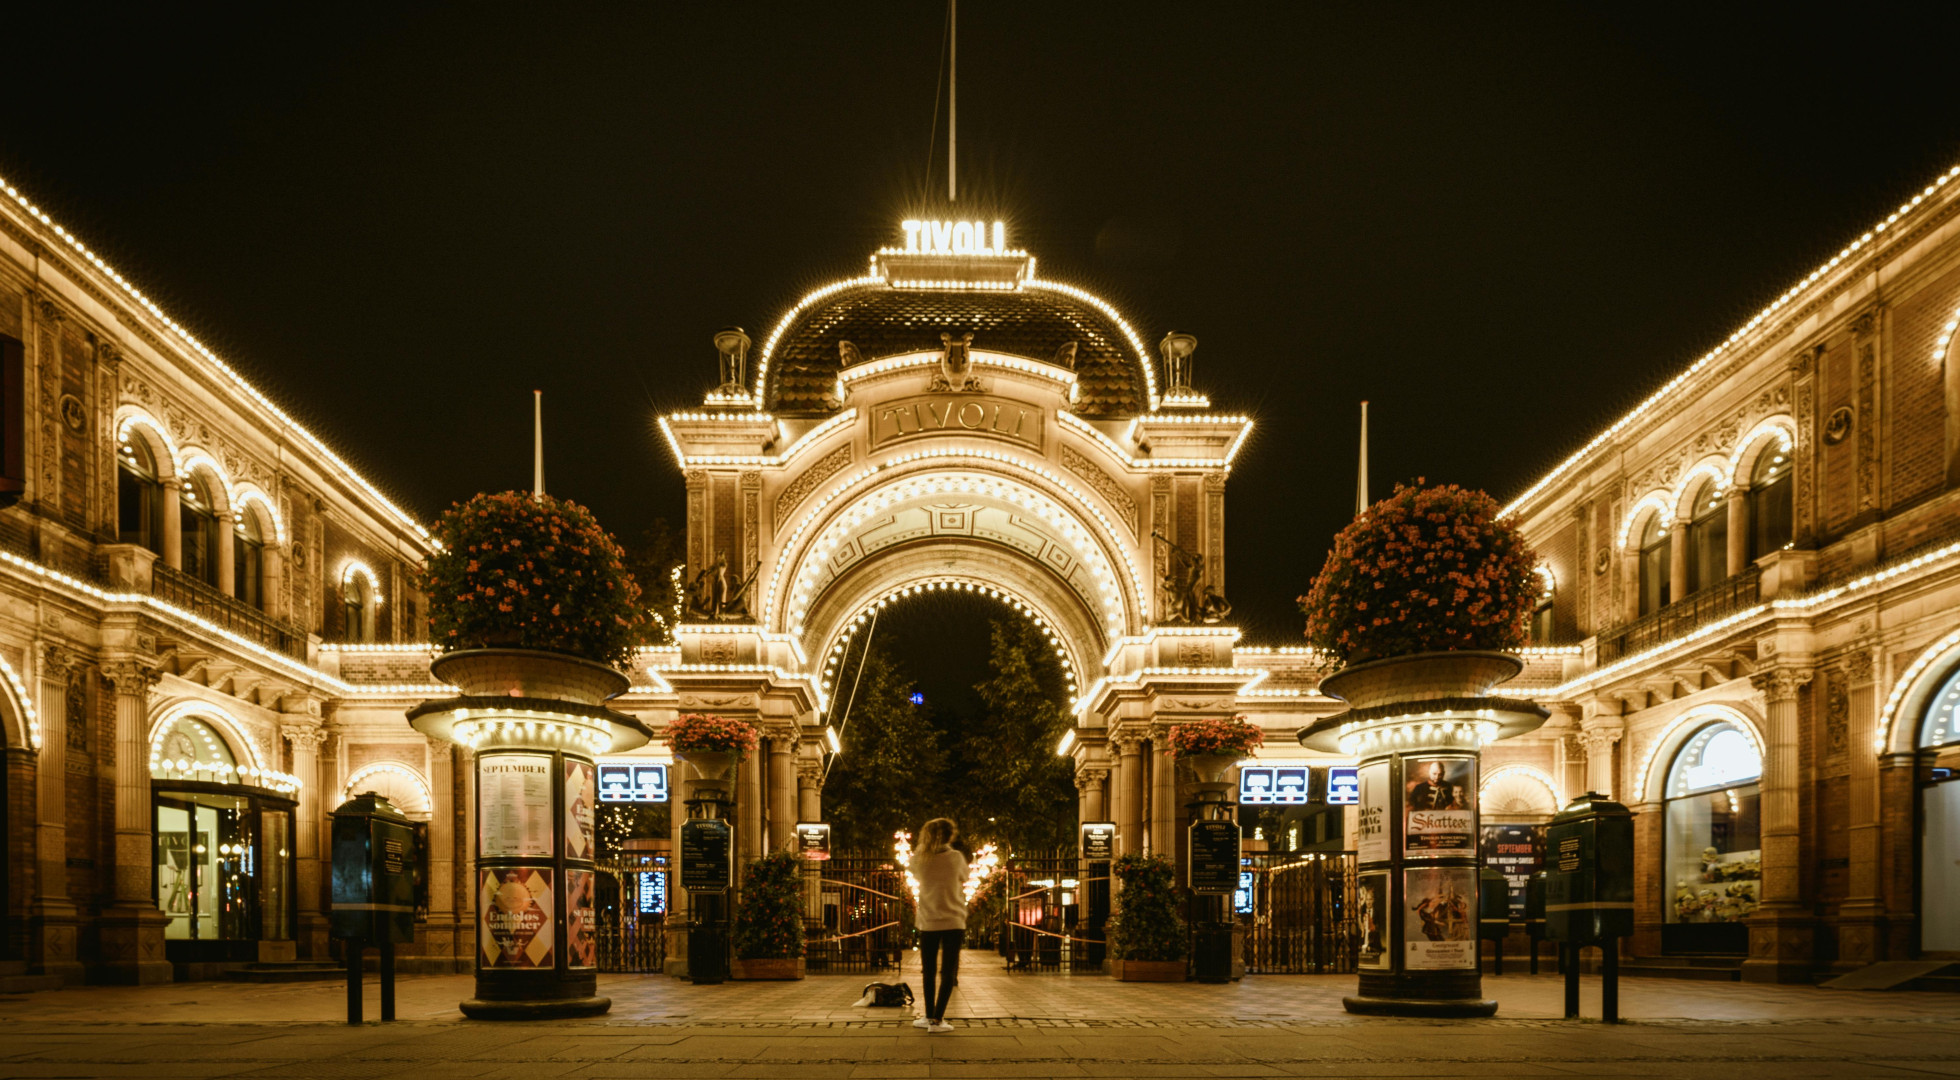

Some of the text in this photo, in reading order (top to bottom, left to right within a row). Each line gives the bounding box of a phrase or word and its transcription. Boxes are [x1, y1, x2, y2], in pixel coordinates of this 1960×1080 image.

[902, 221, 1005, 254] TIVOLI
[883, 402, 1028, 438] TIVOLI
[483, 765, 546, 774] SEPTEMBER
[1497, 844, 1532, 854] SEPTEMBER
[488, 921, 541, 930] sommer
